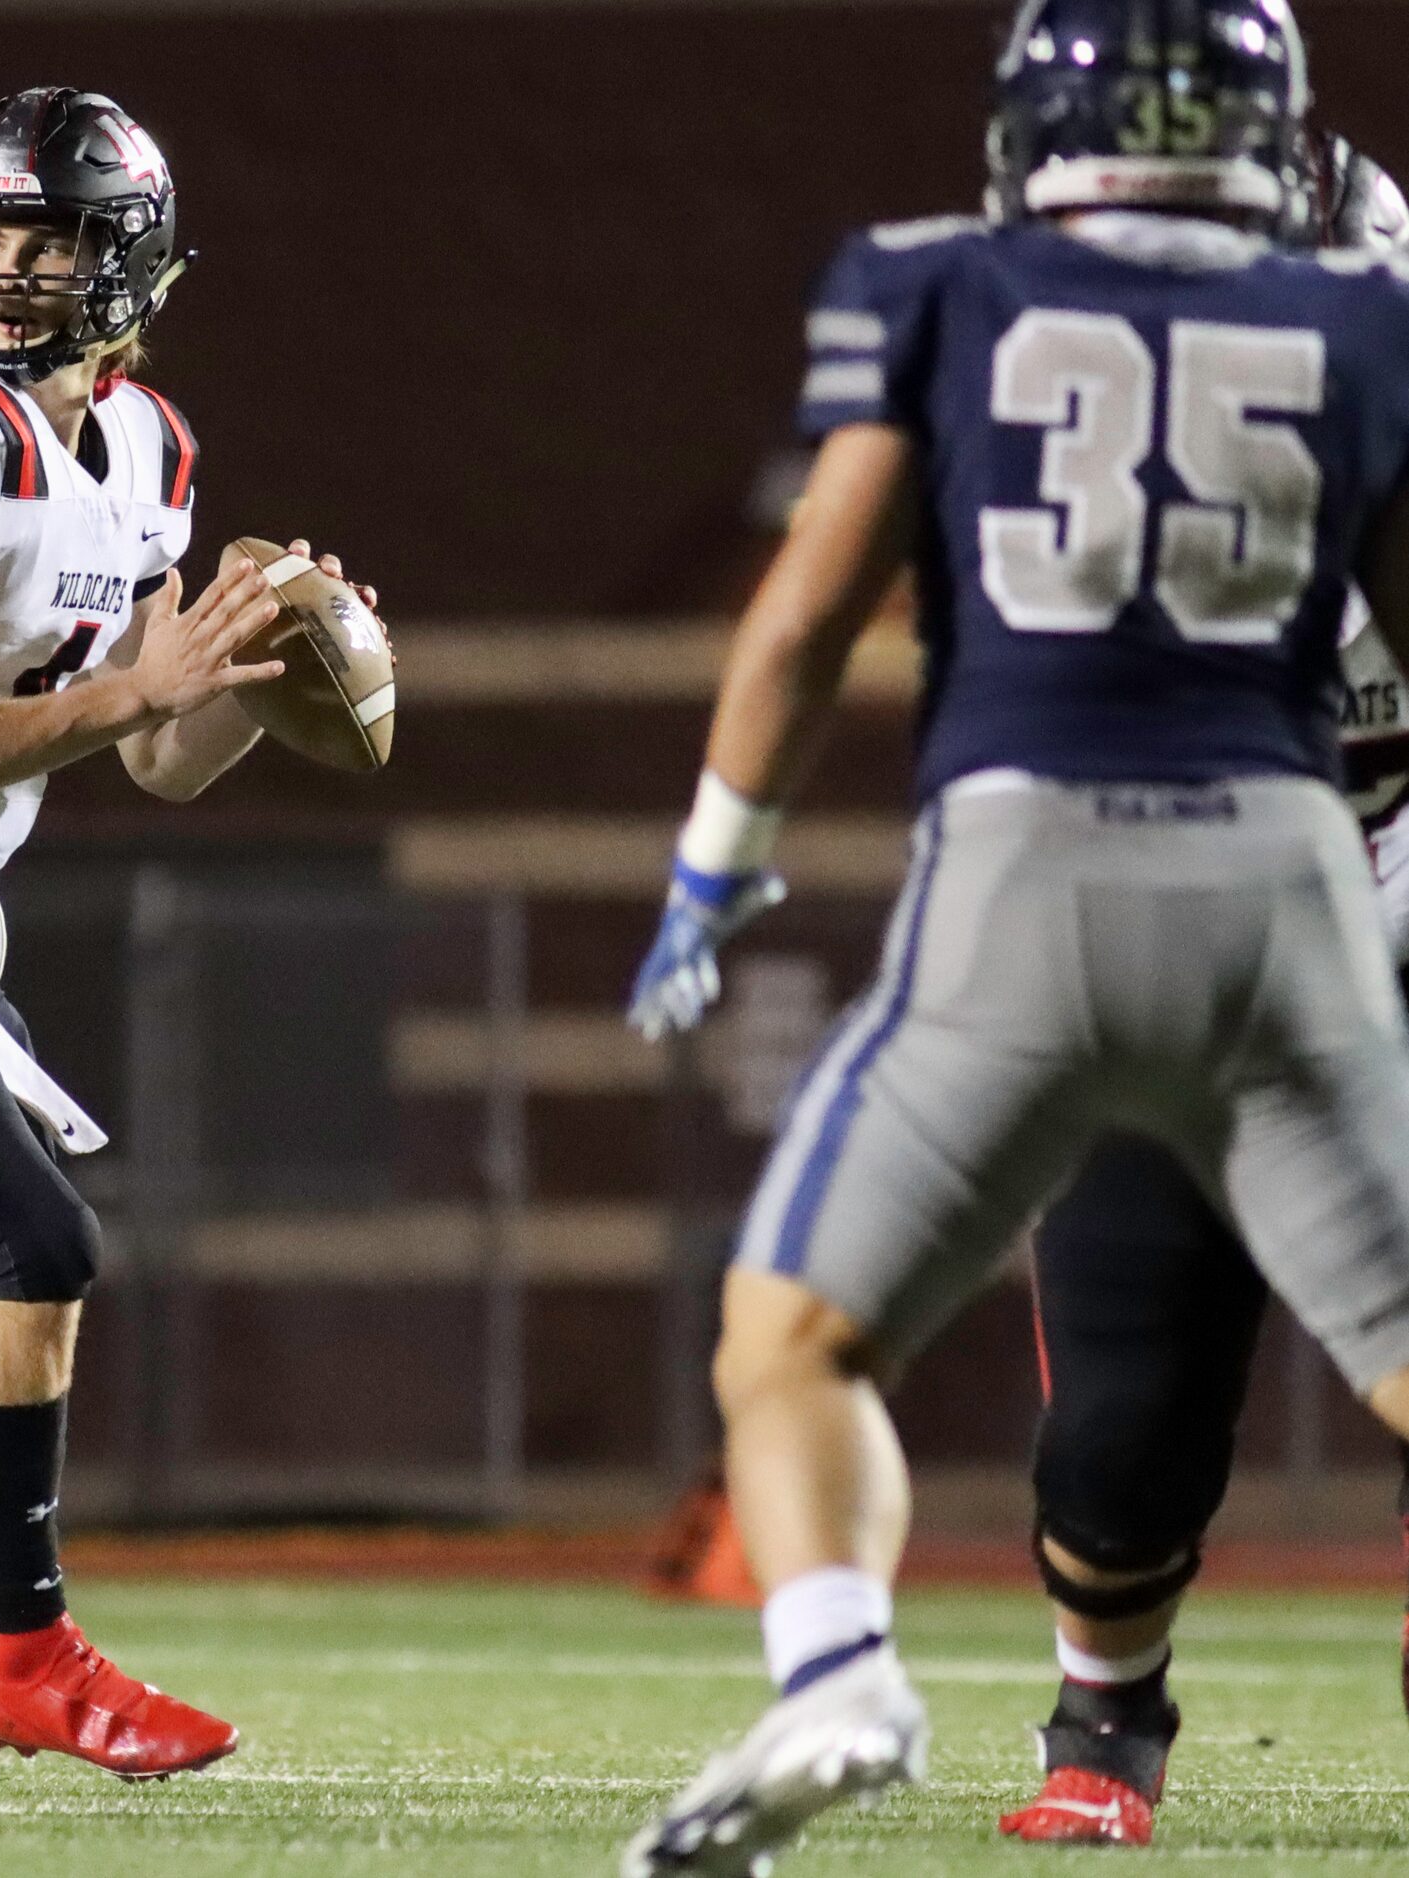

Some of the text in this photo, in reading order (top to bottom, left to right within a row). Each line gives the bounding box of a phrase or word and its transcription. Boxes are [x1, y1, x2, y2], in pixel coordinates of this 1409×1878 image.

[1113, 75, 1214, 152] 35
[13, 177, 28, 190] IT
[979, 307, 1328, 645] 35
[50, 571, 128, 614] WILDCATS
